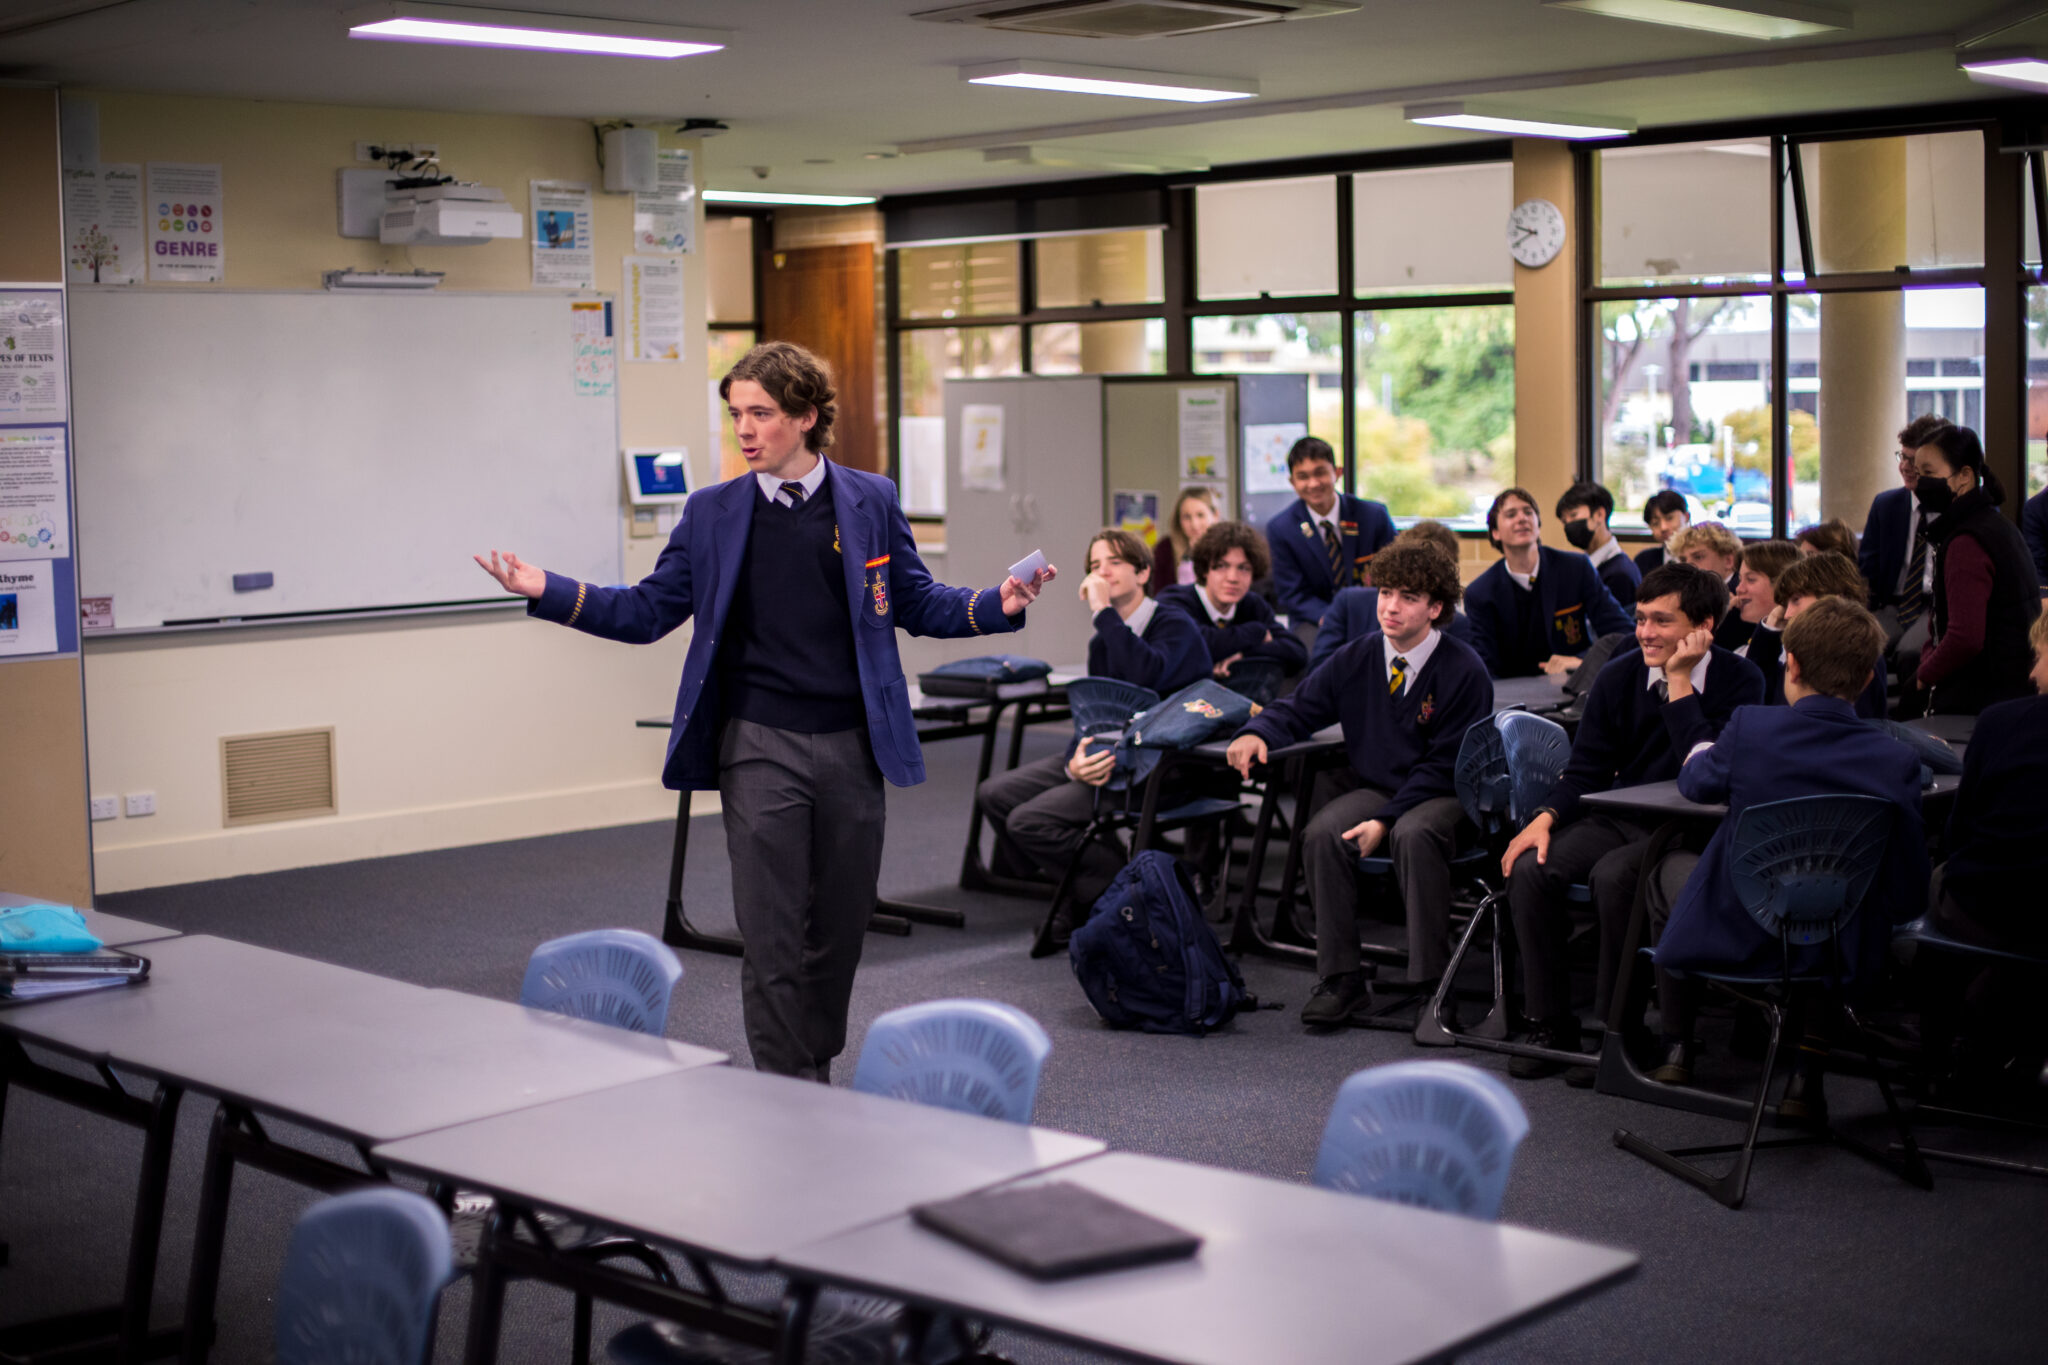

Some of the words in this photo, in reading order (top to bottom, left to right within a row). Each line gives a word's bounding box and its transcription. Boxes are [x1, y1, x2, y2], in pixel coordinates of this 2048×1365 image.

[155, 240, 218, 257] GENRE
[14, 354, 25, 363] OF
[28, 354, 54, 363] TEXTS
